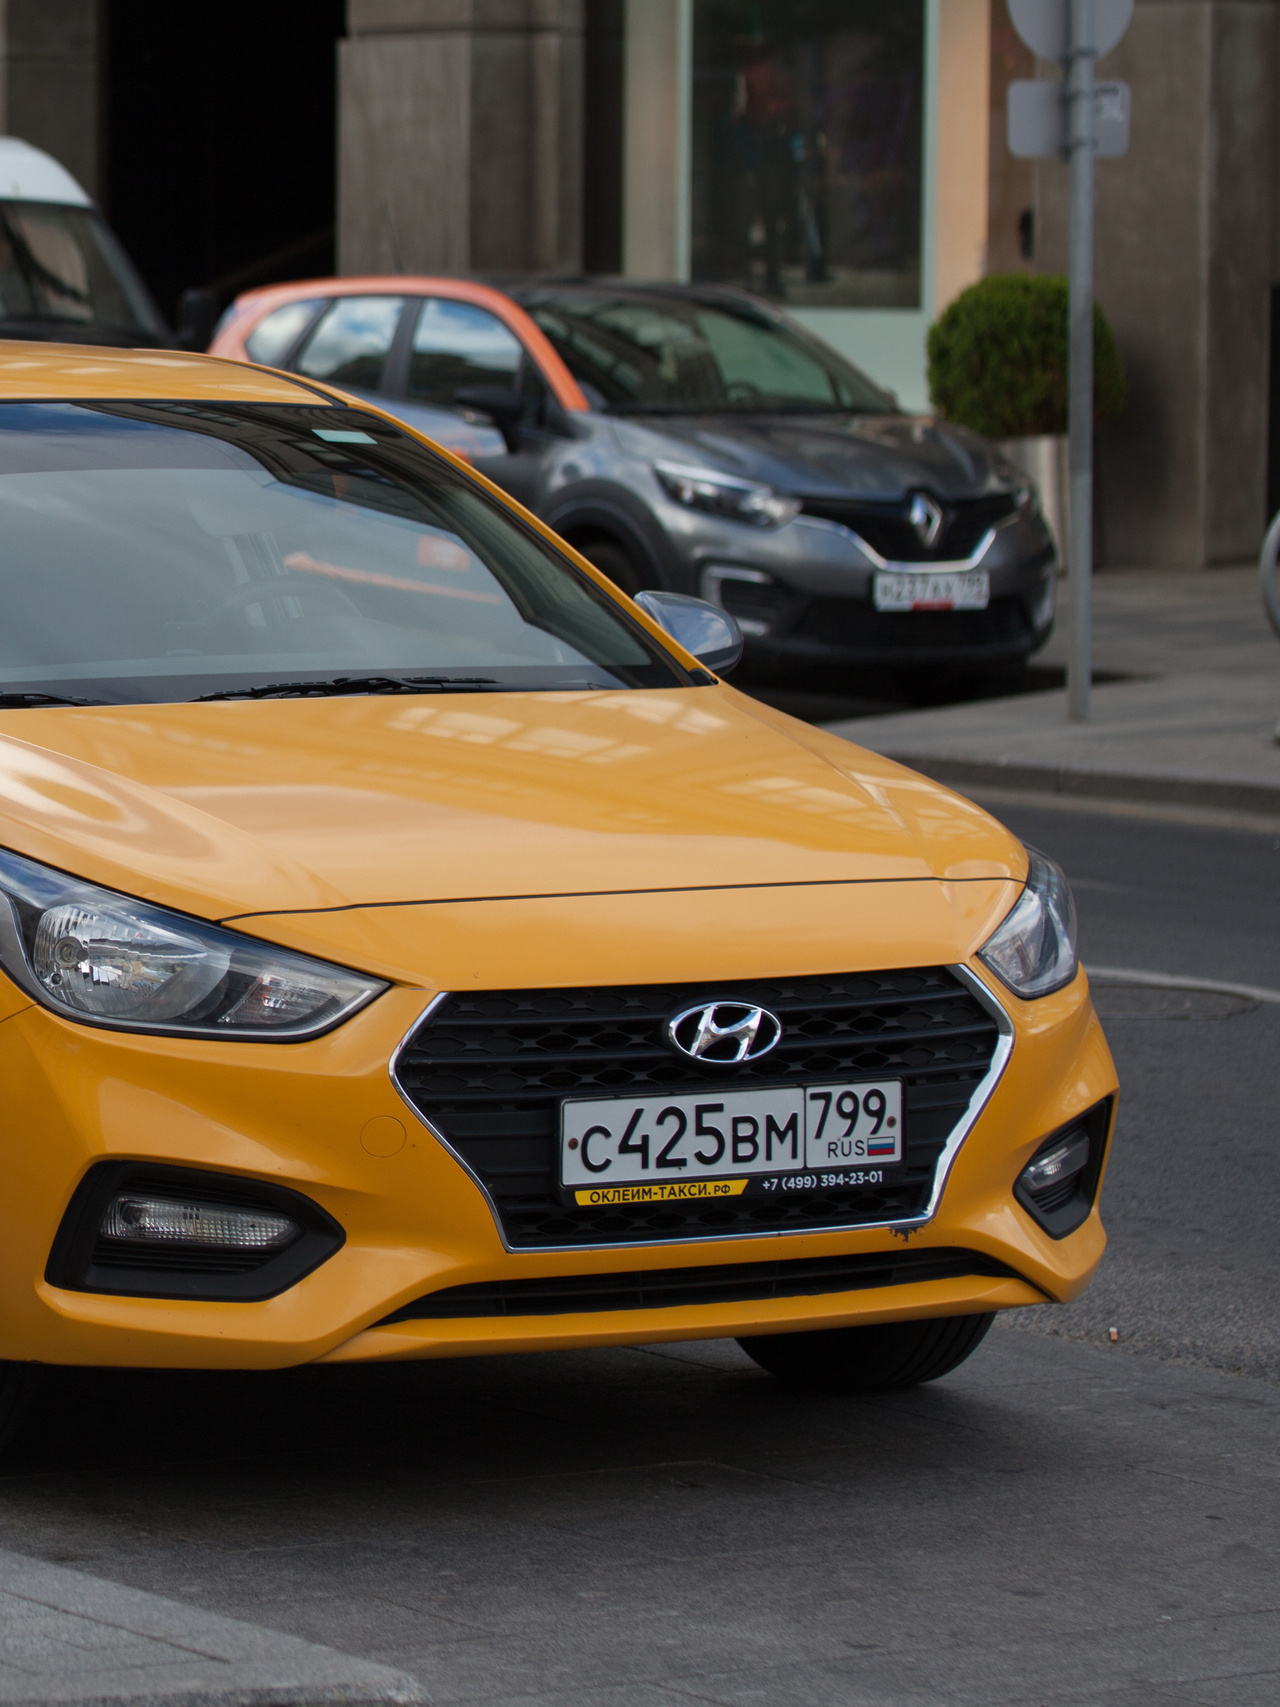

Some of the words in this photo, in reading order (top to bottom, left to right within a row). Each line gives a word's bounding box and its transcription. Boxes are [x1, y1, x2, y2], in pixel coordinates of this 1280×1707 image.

[580, 1102, 798, 1173] С425ВМ
[809, 1088, 887, 1139] 799
[828, 1140, 865, 1158] RUS
[762, 1178, 778, 1190] +7
[781, 1175, 817, 1190] (499)
[820, 1170, 883, 1187] 394-23-01
